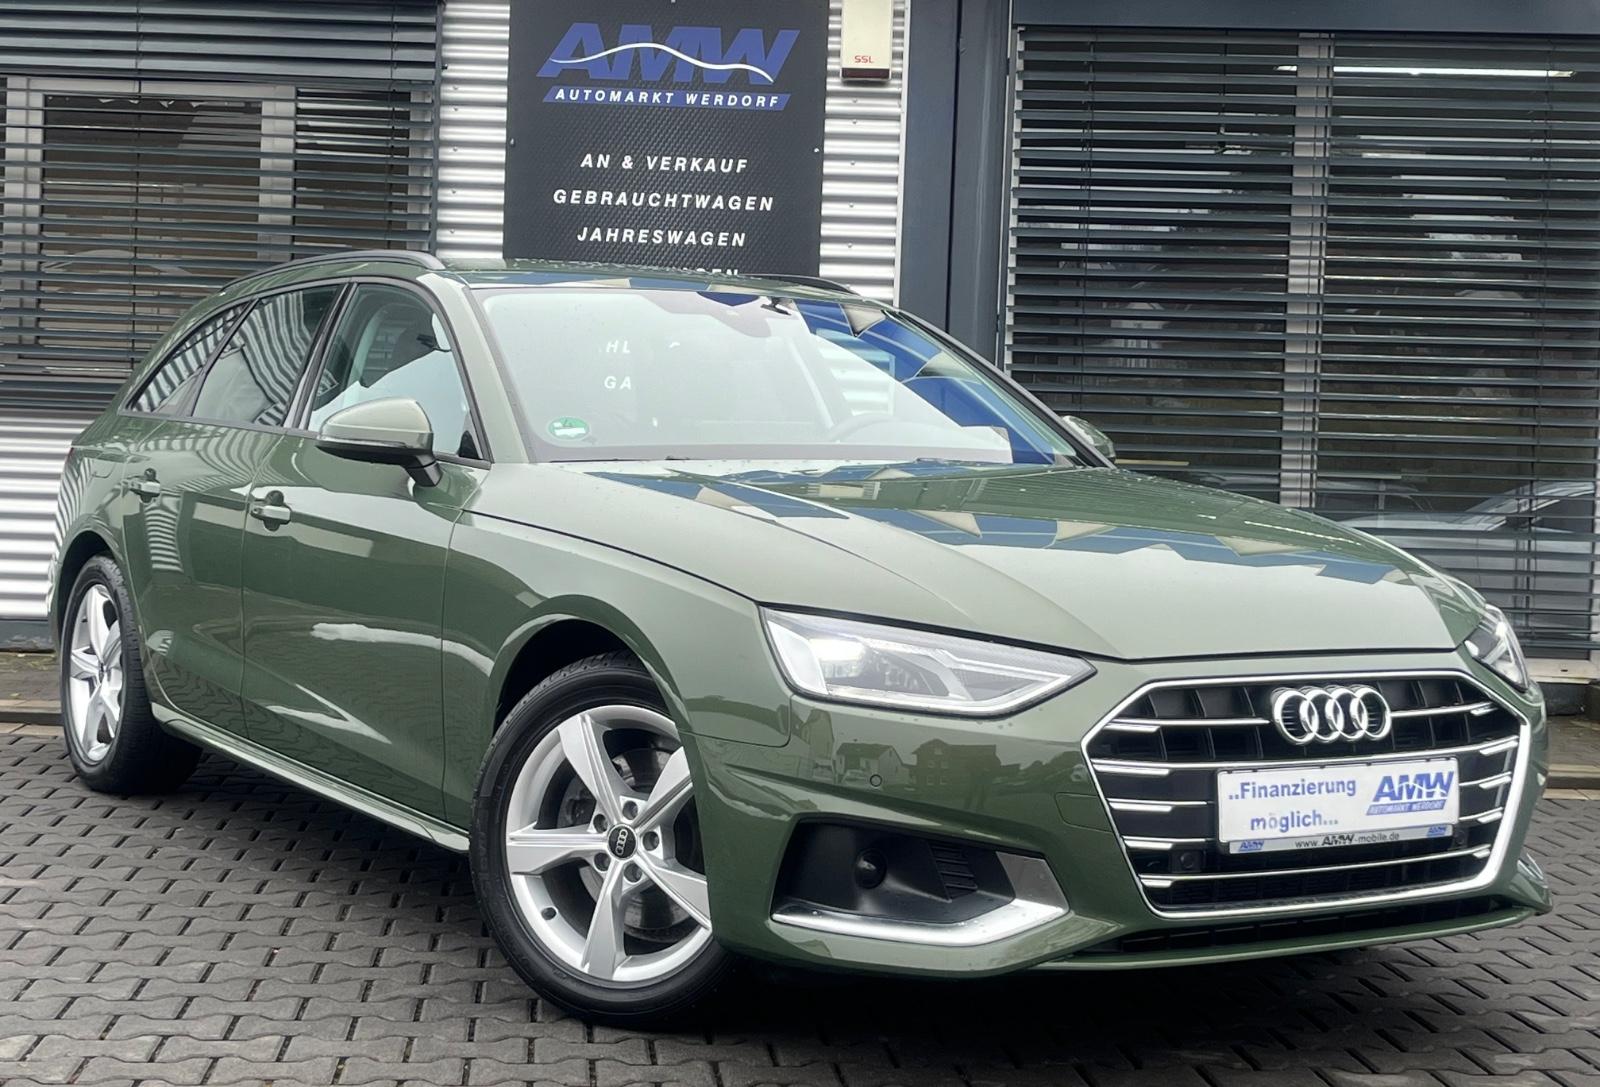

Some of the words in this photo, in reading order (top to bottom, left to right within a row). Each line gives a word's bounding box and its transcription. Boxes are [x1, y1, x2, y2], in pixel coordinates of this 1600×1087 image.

[536, 22, 800, 85] AMW
[854, 55, 874, 64] SSL
[555, 88, 675, 105] AUTOMARKT
[685, 92, 780, 108] WERDORF
[580, 153, 611, 169] AN
[621, 155, 635, 170] &
[647, 155, 748, 174] VERKAUF
[553, 189, 775, 212] GEBRAUCHTWAGEN
[576, 226, 746, 247] JAHRESWAGEN
[1372, 771, 1455, 802] AMW
